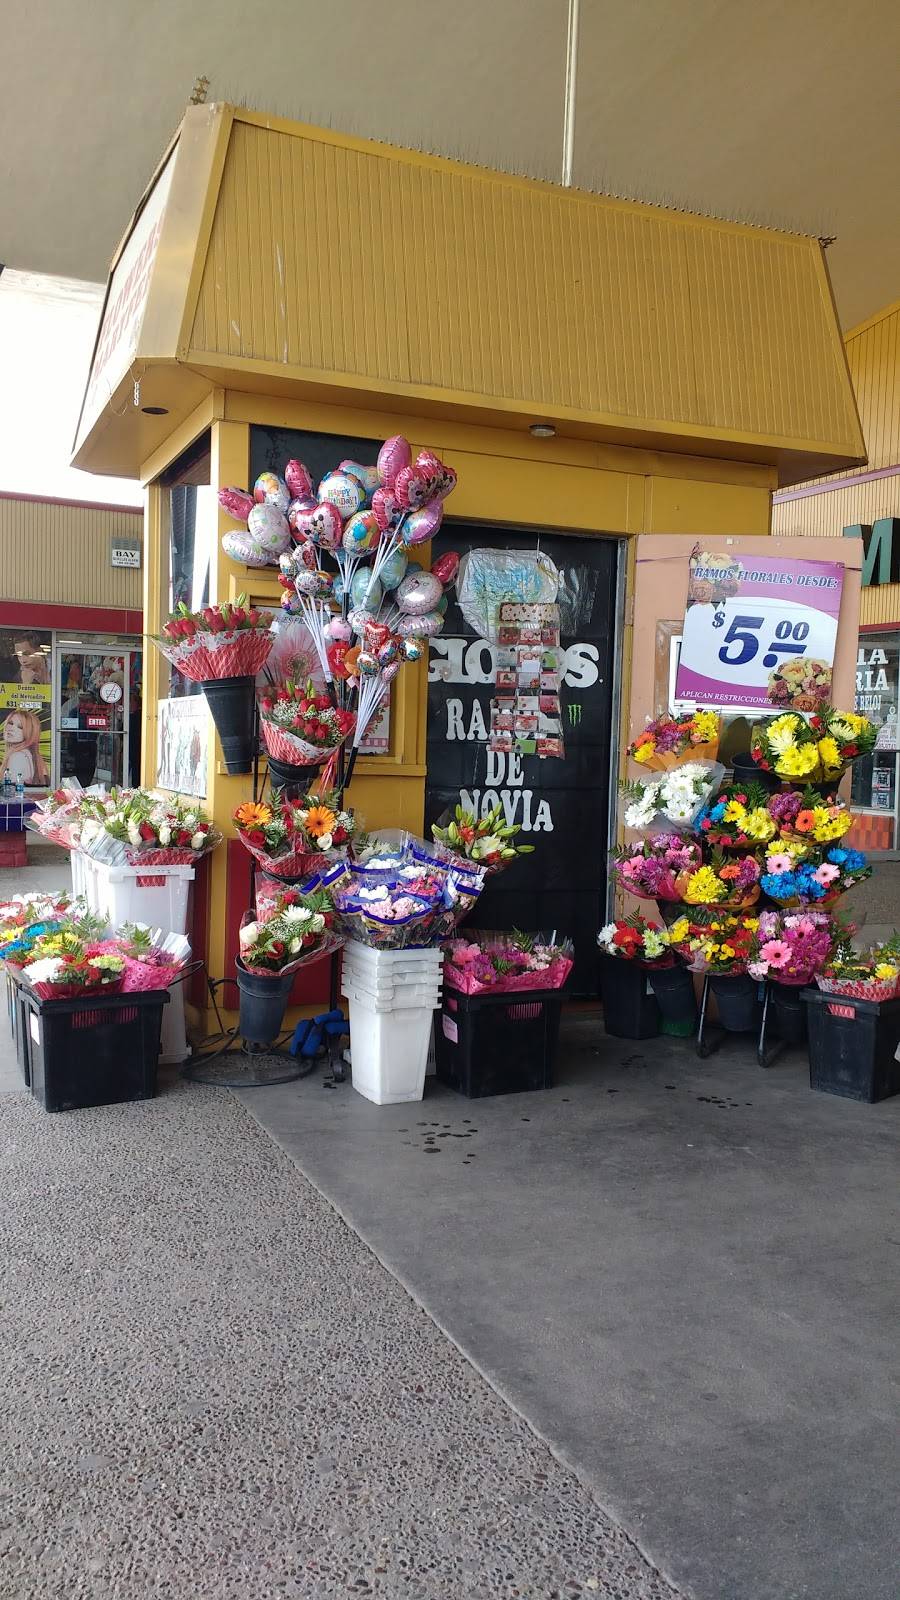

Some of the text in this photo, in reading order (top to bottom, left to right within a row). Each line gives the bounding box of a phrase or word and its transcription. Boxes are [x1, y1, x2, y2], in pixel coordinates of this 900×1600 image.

[694, 567, 838, 588] RAMOS FLORALES DESDE:
[428, 637, 600, 688] GLOS
[680, 690, 773, 705] APLICAN RESTRICCIONES
[446, 698, 548, 741] RAM
[485, 744, 525, 786] DE
[459, 788, 554, 832] NOVIA
